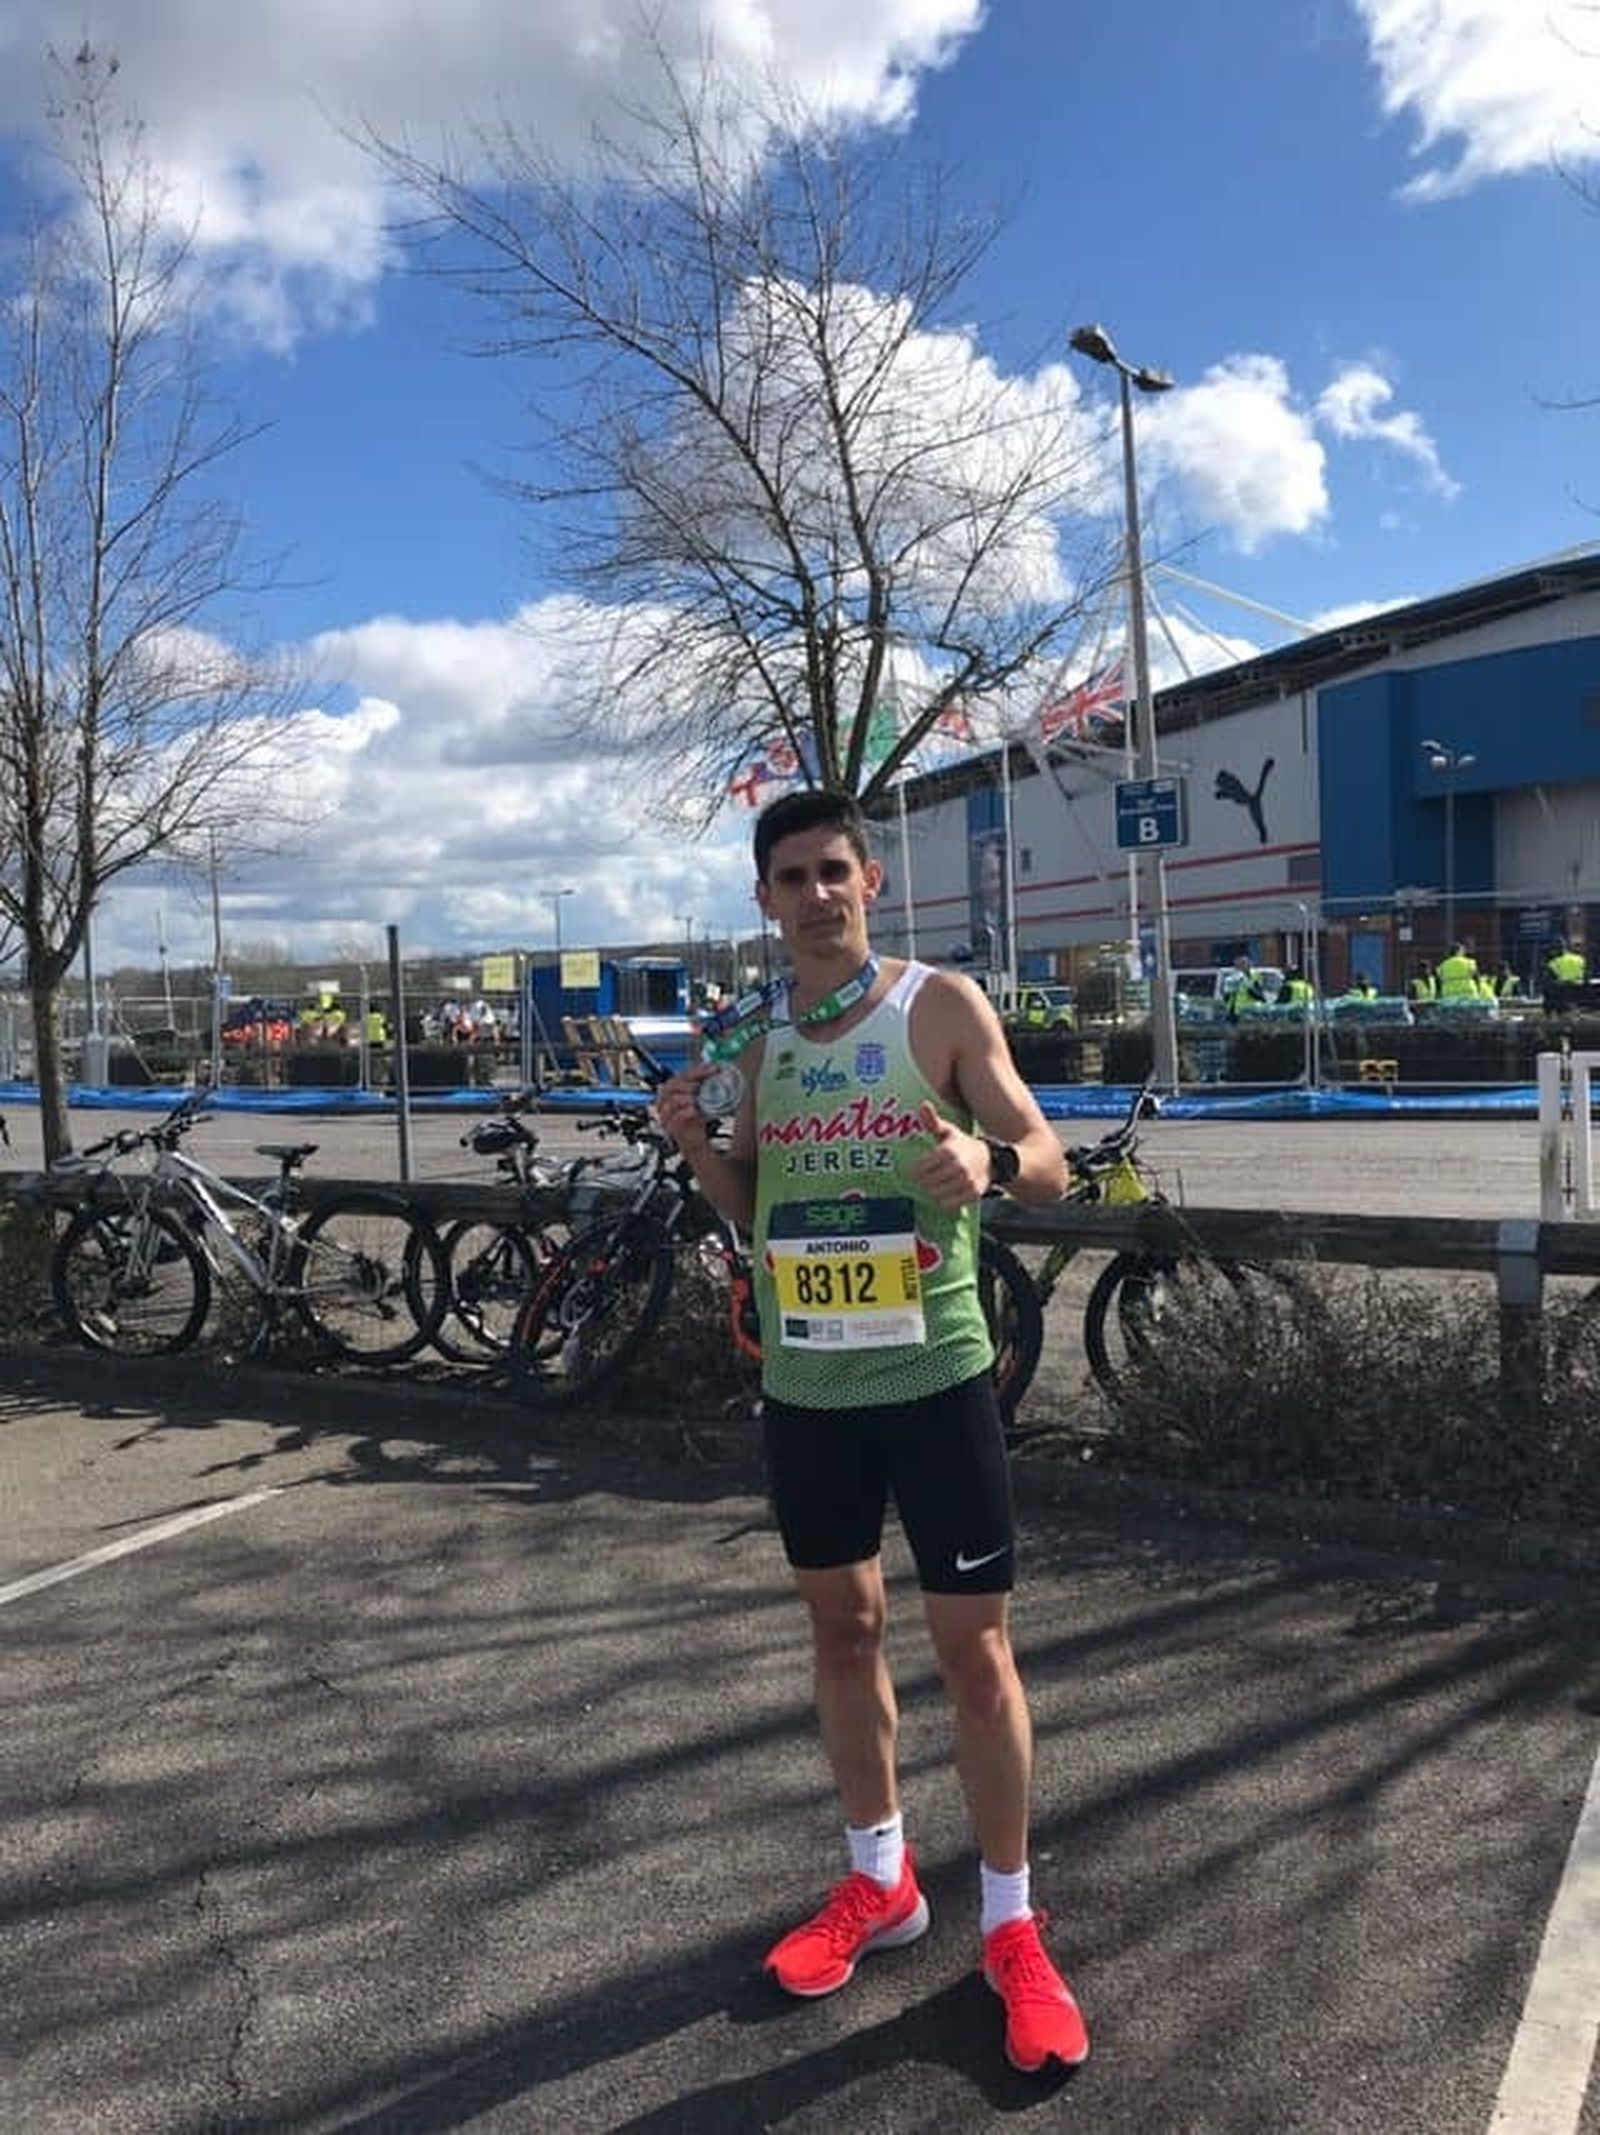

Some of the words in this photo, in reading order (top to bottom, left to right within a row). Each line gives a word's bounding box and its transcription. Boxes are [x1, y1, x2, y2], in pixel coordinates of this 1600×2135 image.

[1139, 817, 1160, 842] B
[785, 1148, 892, 1174] JEREZ
[806, 1239, 870, 1254] ANTONIO
[795, 1262, 878, 1305] 8312
